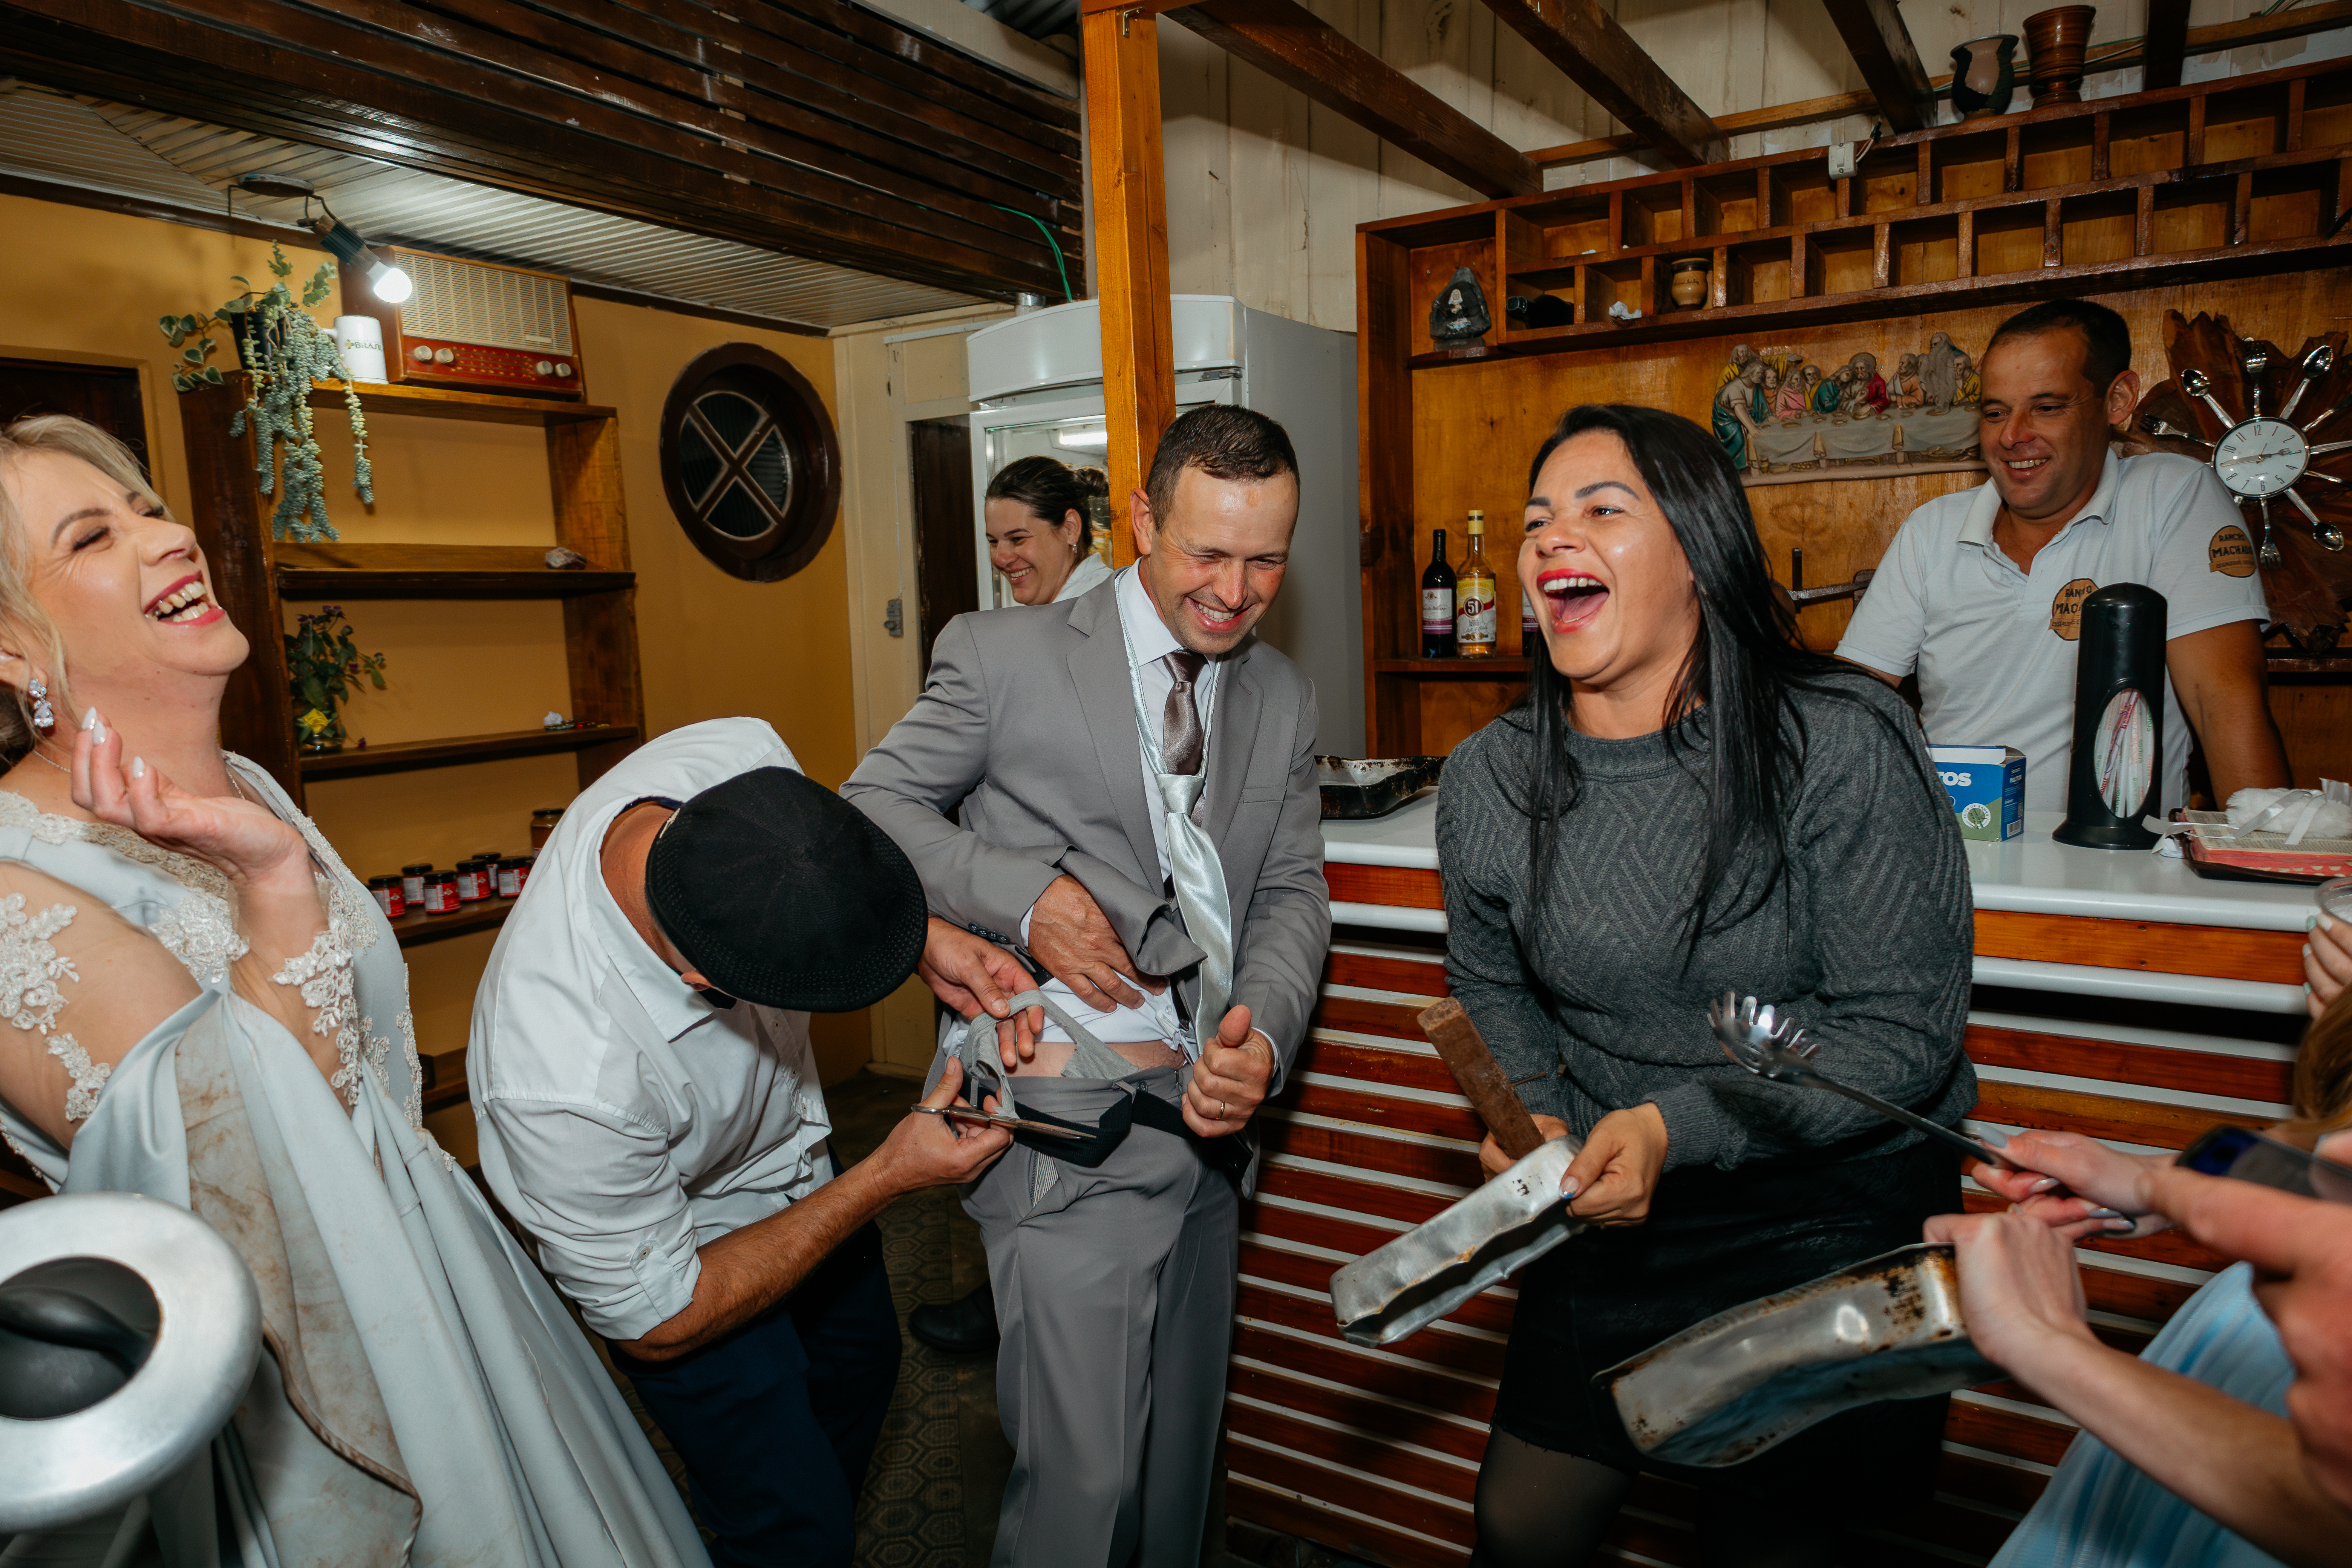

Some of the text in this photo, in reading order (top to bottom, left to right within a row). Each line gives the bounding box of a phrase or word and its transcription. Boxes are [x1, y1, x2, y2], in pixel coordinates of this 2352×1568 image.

[2254, 425, 2262, 436] 12
[2272, 426, 2278, 436] 1
[2236, 432, 2246, 442] 11
[2283, 435, 2295, 443] 2
[2223, 445, 2236, 453] 10
[2242, 479, 2249, 490] 7
[2275, 475, 2285, 484] 5
[2260, 481, 2265, 492] 6
[1467, 600, 1479, 614] 51
